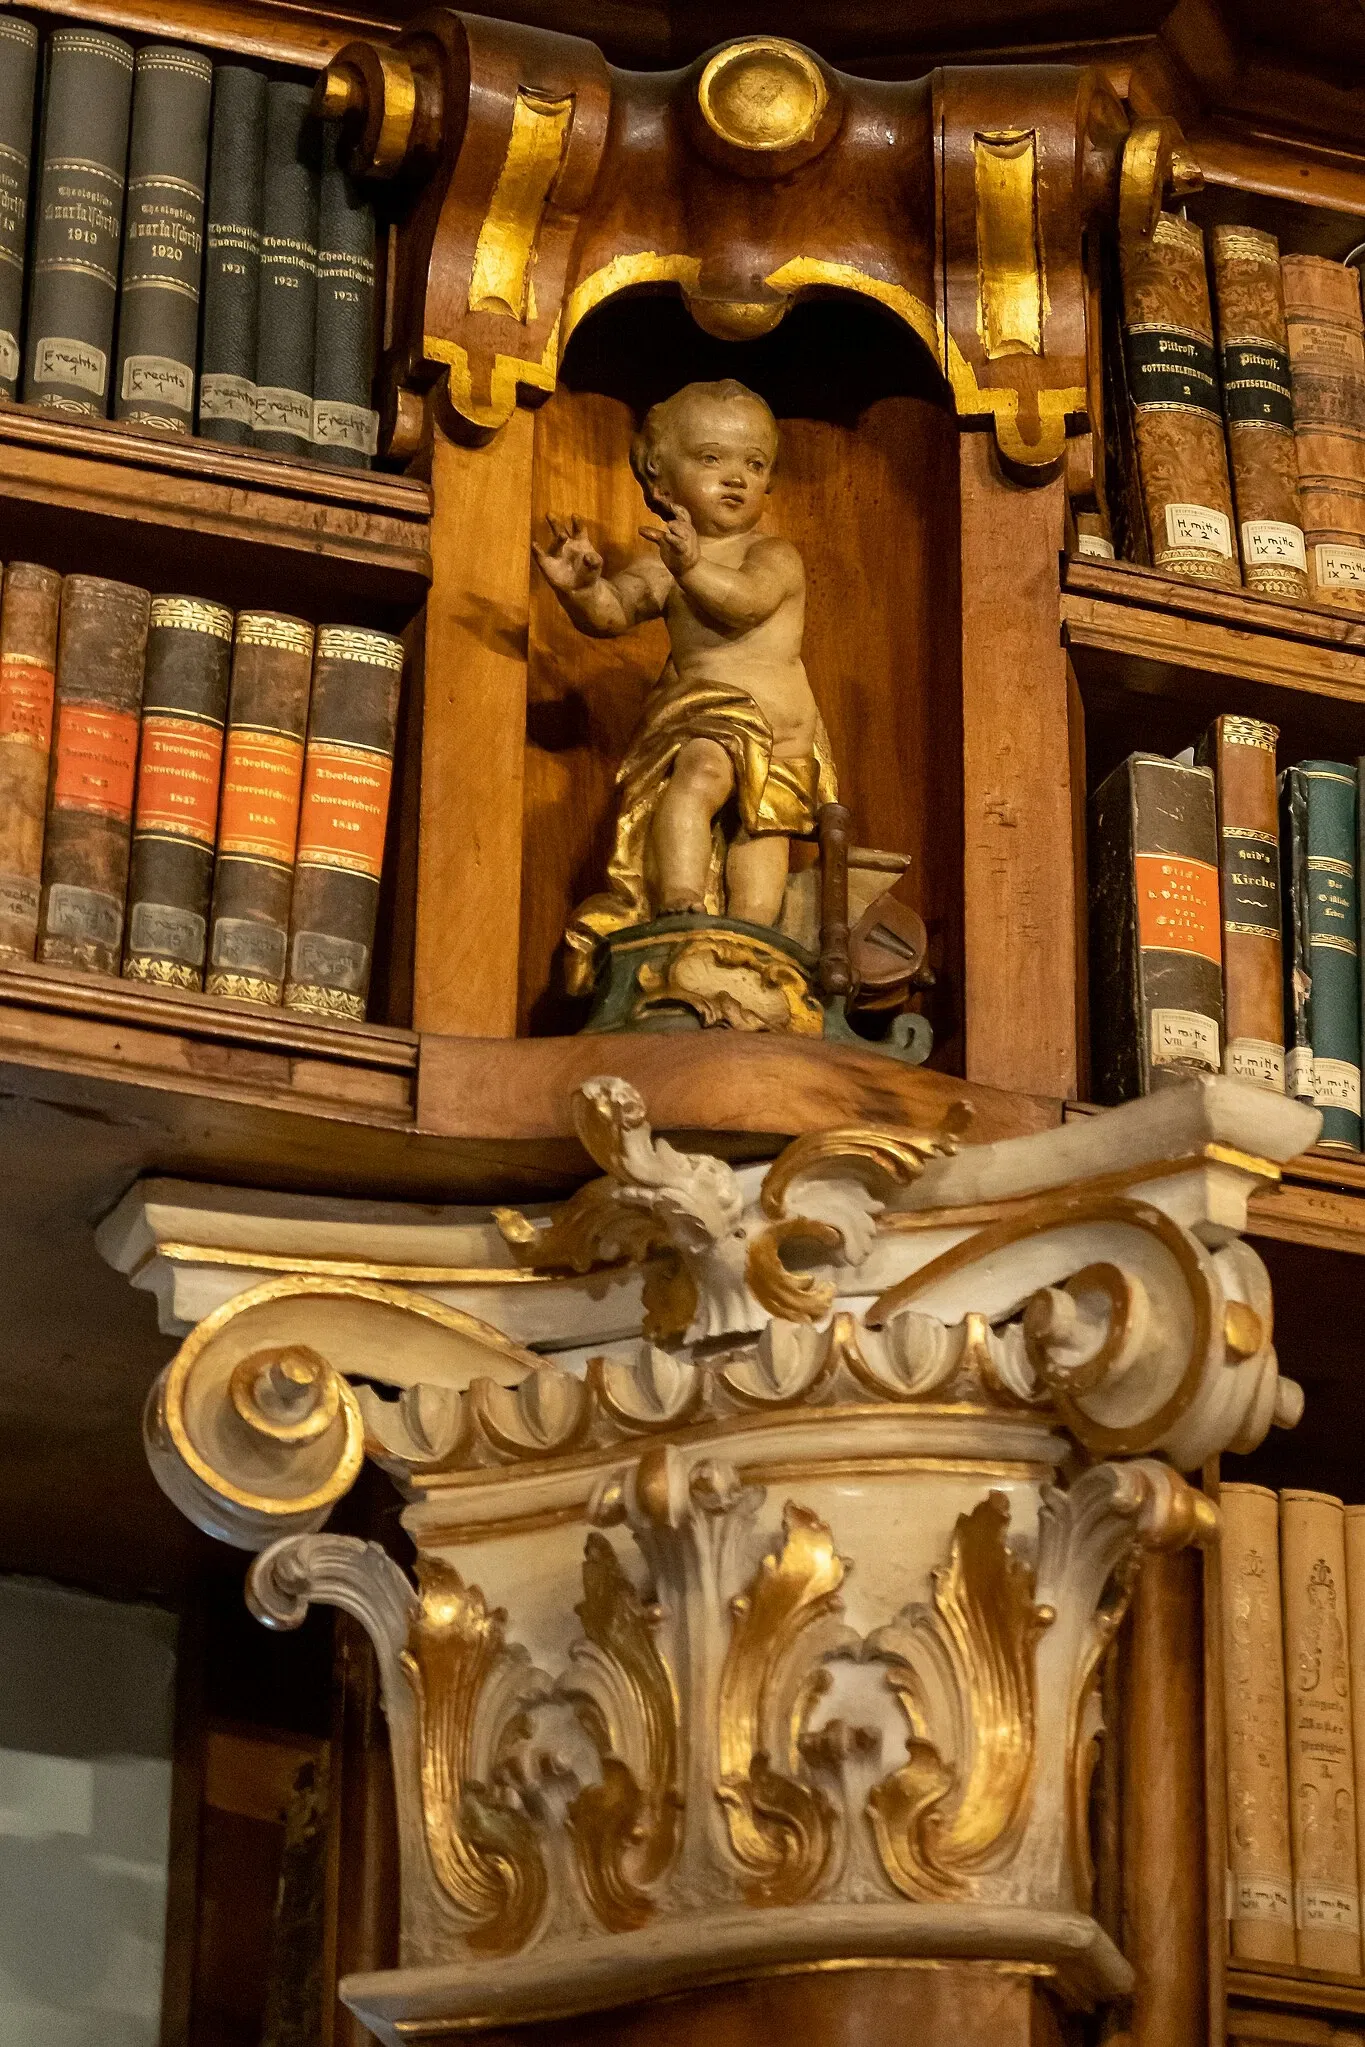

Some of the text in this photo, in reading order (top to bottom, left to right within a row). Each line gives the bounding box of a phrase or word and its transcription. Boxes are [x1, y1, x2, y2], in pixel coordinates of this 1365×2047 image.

[68, 227, 98, 245] 1919
[152, 245, 182, 260] 1920
[222, 263, 246, 275] 1921
[274, 275, 299, 289] 1922
[334, 290, 359, 302] 1923
[44, 363, 77, 375] X 1
[132, 381, 163, 393] X 1
[1183, 386, 1191, 395] 2
[1263, 404, 1271, 413] 3
[254, 411, 287, 423] X 1
[317, 425, 347, 438] X 1
[1177, 519, 1221, 536] H mitte
[1181, 530, 1210, 540] IX 2
[1253, 536, 1295, 548] H mitte
[1257, 546, 1286, 556] IX 2
[1326, 559, 1335, 568] H
[1350, 572, 1359, 580] 2
[1231, 873, 1276, 890] Kirche
[1175, 908, 1197, 918] von
[1163, 1024, 1172, 1034] H
[1164, 1037, 1183, 1046] VIII
[1233, 1054, 1280, 1072] H mitte
[1234, 1066, 1274, 1081] VIII 2
